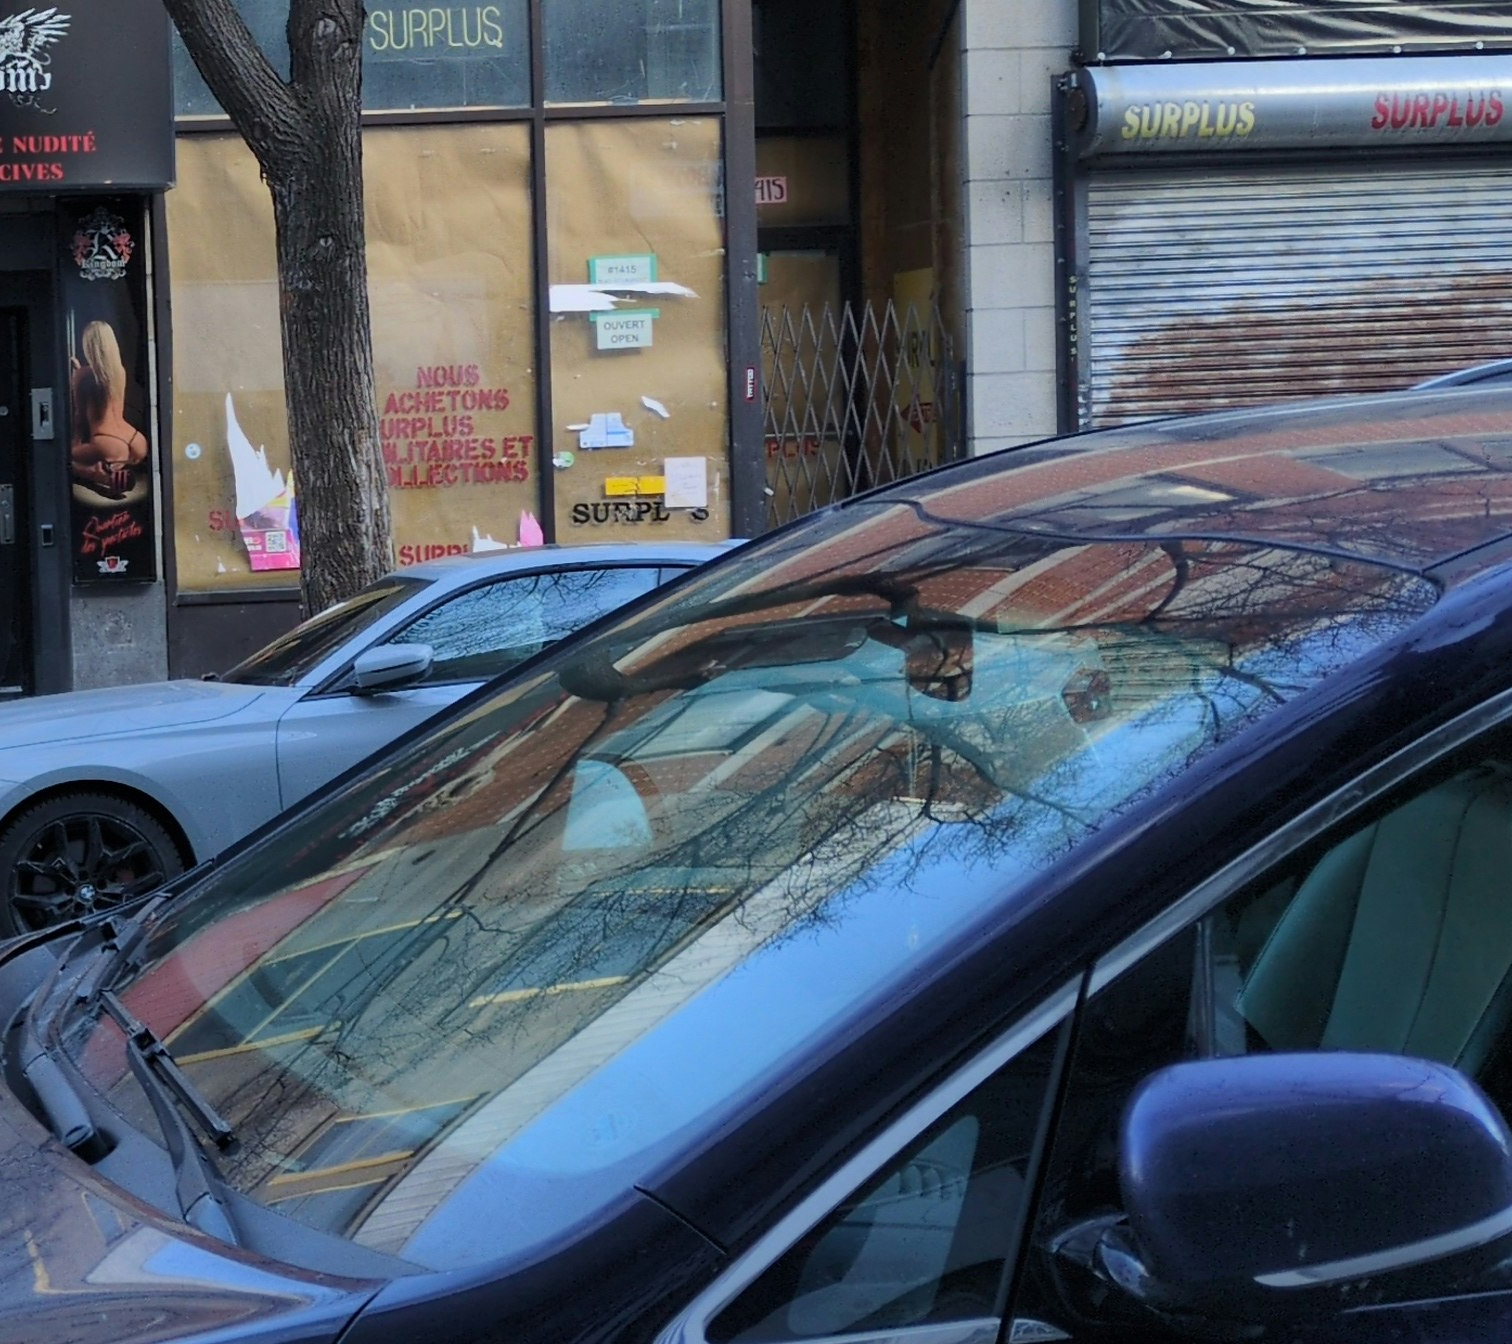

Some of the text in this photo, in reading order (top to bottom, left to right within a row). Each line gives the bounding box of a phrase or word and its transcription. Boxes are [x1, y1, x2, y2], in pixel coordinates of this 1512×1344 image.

[370, 6, 503, 50] SURPLUS
[1122, 100, 1256, 140] SURPLUS
[1371, 90, 1504, 131] SURPLUS
[13, 132, 96, 153] NUDITÉ
[608, 265, 637, 274] #1415
[603, 320, 645, 331] OUVERT
[611, 335, 639, 344] OPEN
[416, 364, 480, 389] NOUS
[384, 389, 509, 415] ACHETONS
[380, 416, 475, 440] URPLUS
[381, 436, 533, 464] ILITAIRES ET
[387, 461, 529, 488] OLLECTIONS
[572, 502, 710, 524] SURPLS
